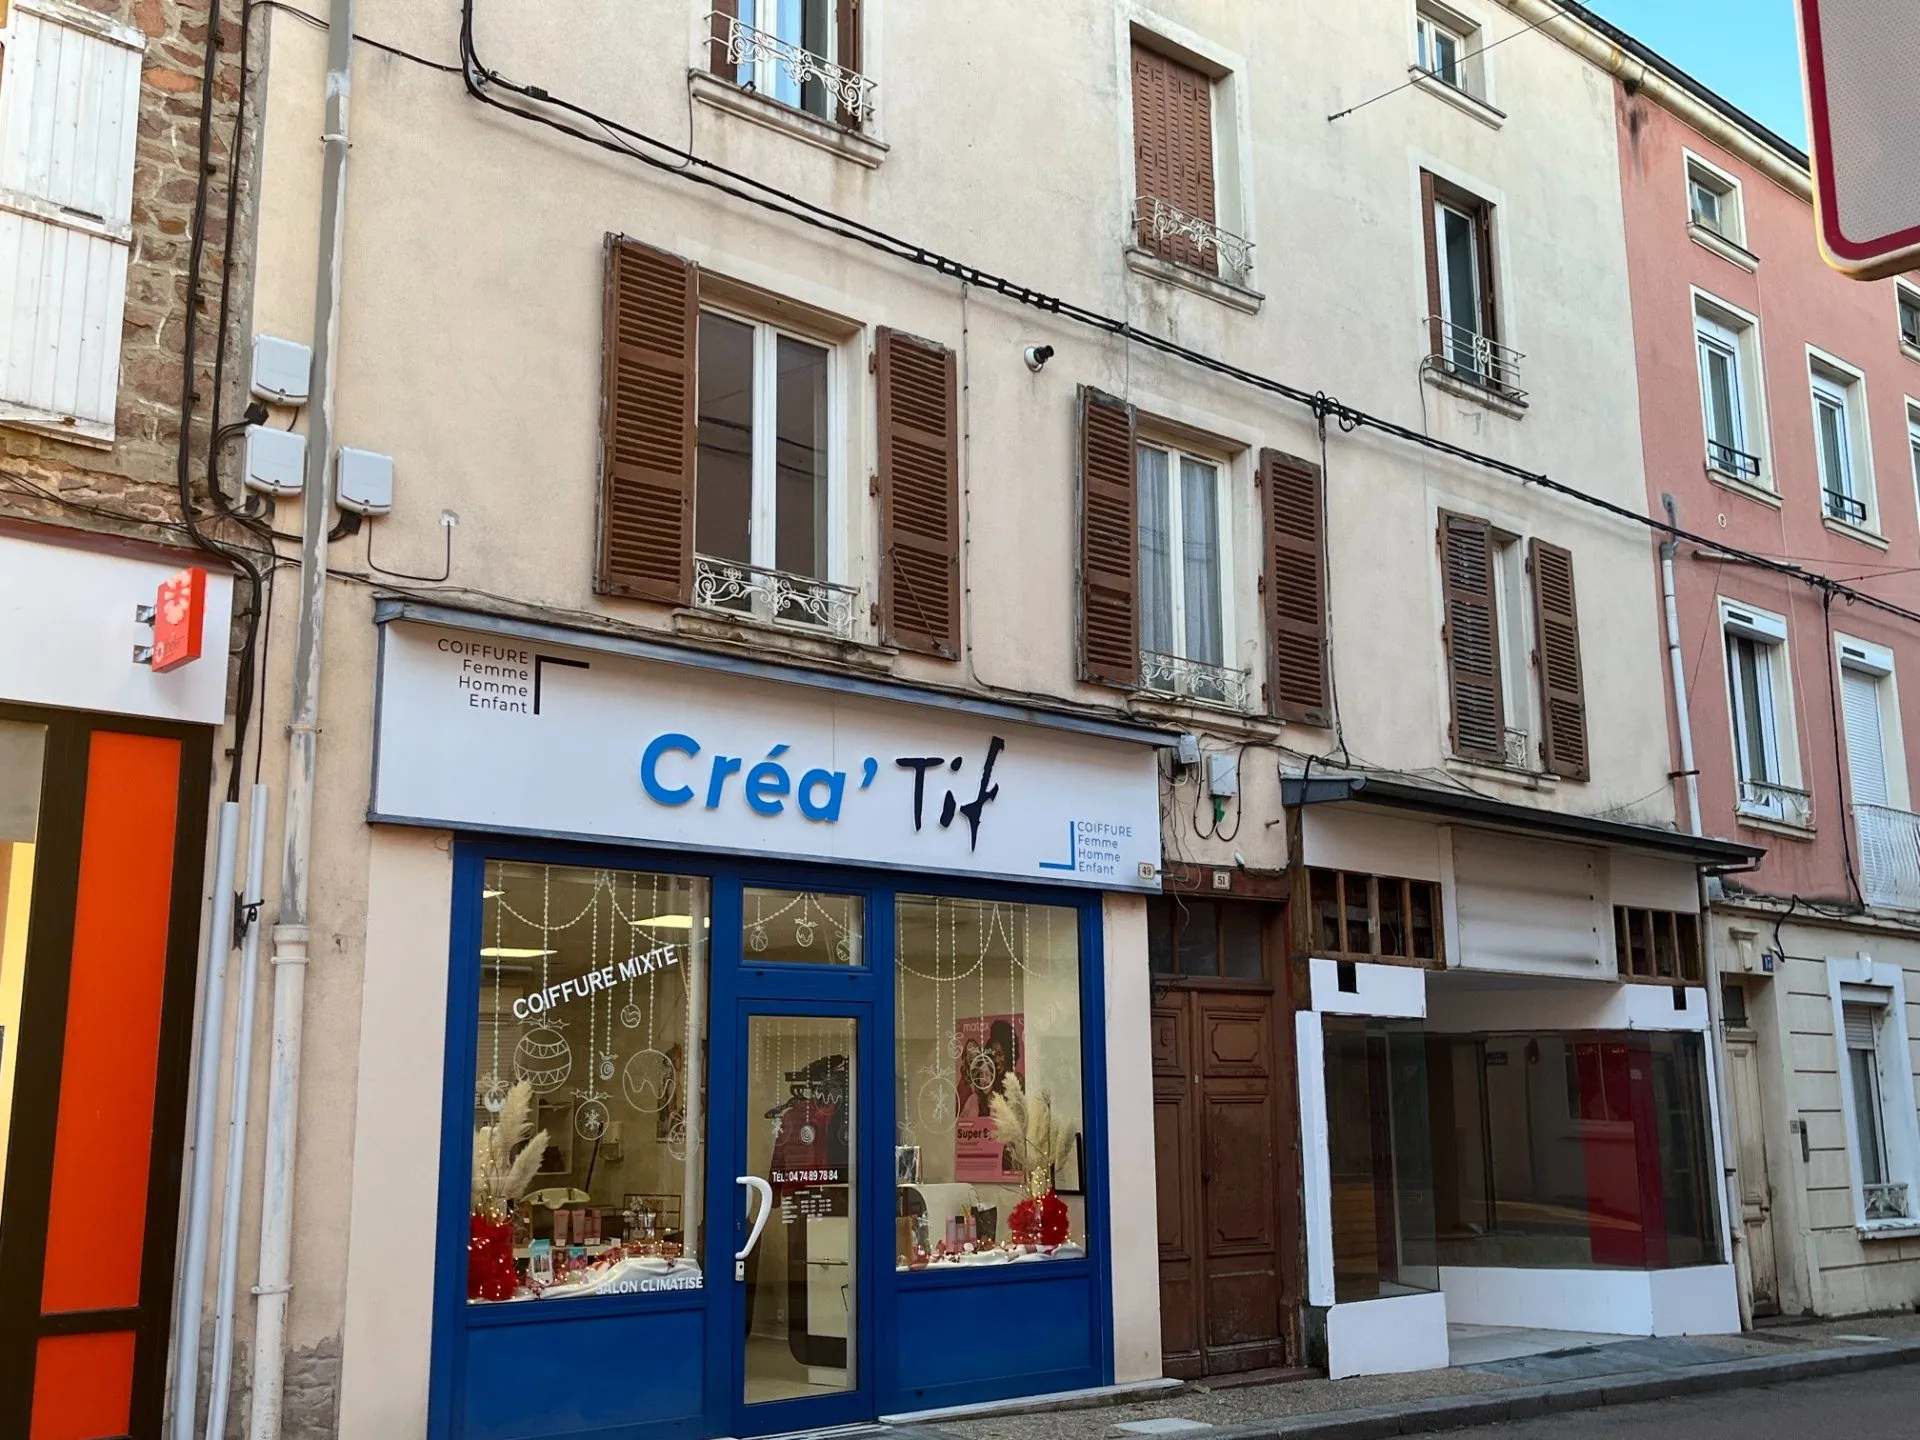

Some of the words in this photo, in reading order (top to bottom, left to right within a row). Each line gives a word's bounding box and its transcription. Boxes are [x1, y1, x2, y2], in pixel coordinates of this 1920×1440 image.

[438, 638, 529, 665] COIFFURE
[463, 658, 529, 681] Femme
[459, 675, 529, 697] Homme
[469, 693, 528, 714] Enfant
[895, 735, 1006, 853] Tif
[1077, 821, 1133, 838] COIFFURE
[1078, 834, 1119, 849] Femme
[1078, 848, 1121, 863] Homme
[1079, 861, 1115, 876] Enfant
[1141, 865, 1152, 877] 49
[1217, 875, 1226, 886] 51
[512, 965, 618, 1020] COIFFURE
[618, 943, 679, 983] MIXTE
[957, 1127, 983, 1142] Super
[788, 1171, 798, 1182] 04
[799, 1170, 808, 1182] 74
[808, 1170, 818, 1181] 89
[818, 1169, 828, 1181] 78
[828, 1169, 838, 1181] 84
[596, 1279, 638, 1295] SALON
